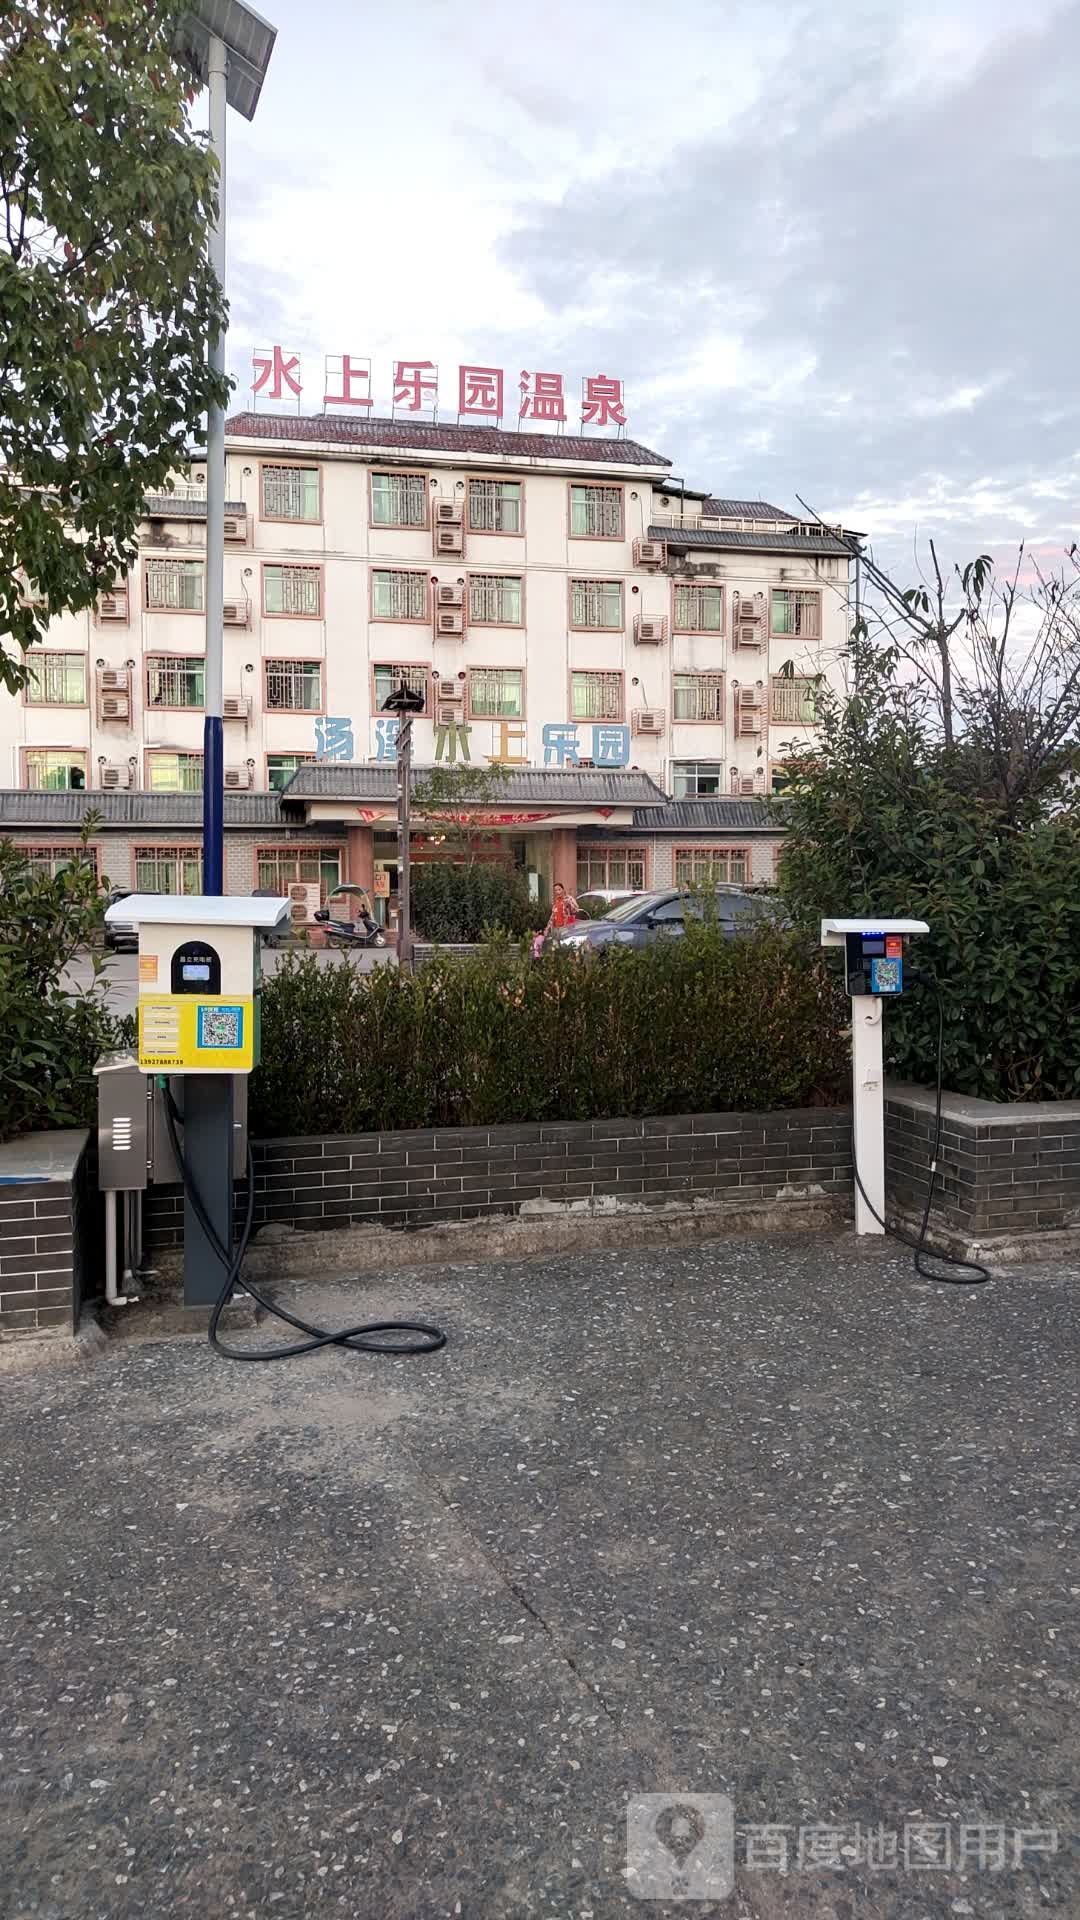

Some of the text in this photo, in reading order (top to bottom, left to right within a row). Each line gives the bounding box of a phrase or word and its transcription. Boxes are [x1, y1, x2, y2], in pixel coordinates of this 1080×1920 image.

[250, 345, 627, 426] 水上乐园温泉
